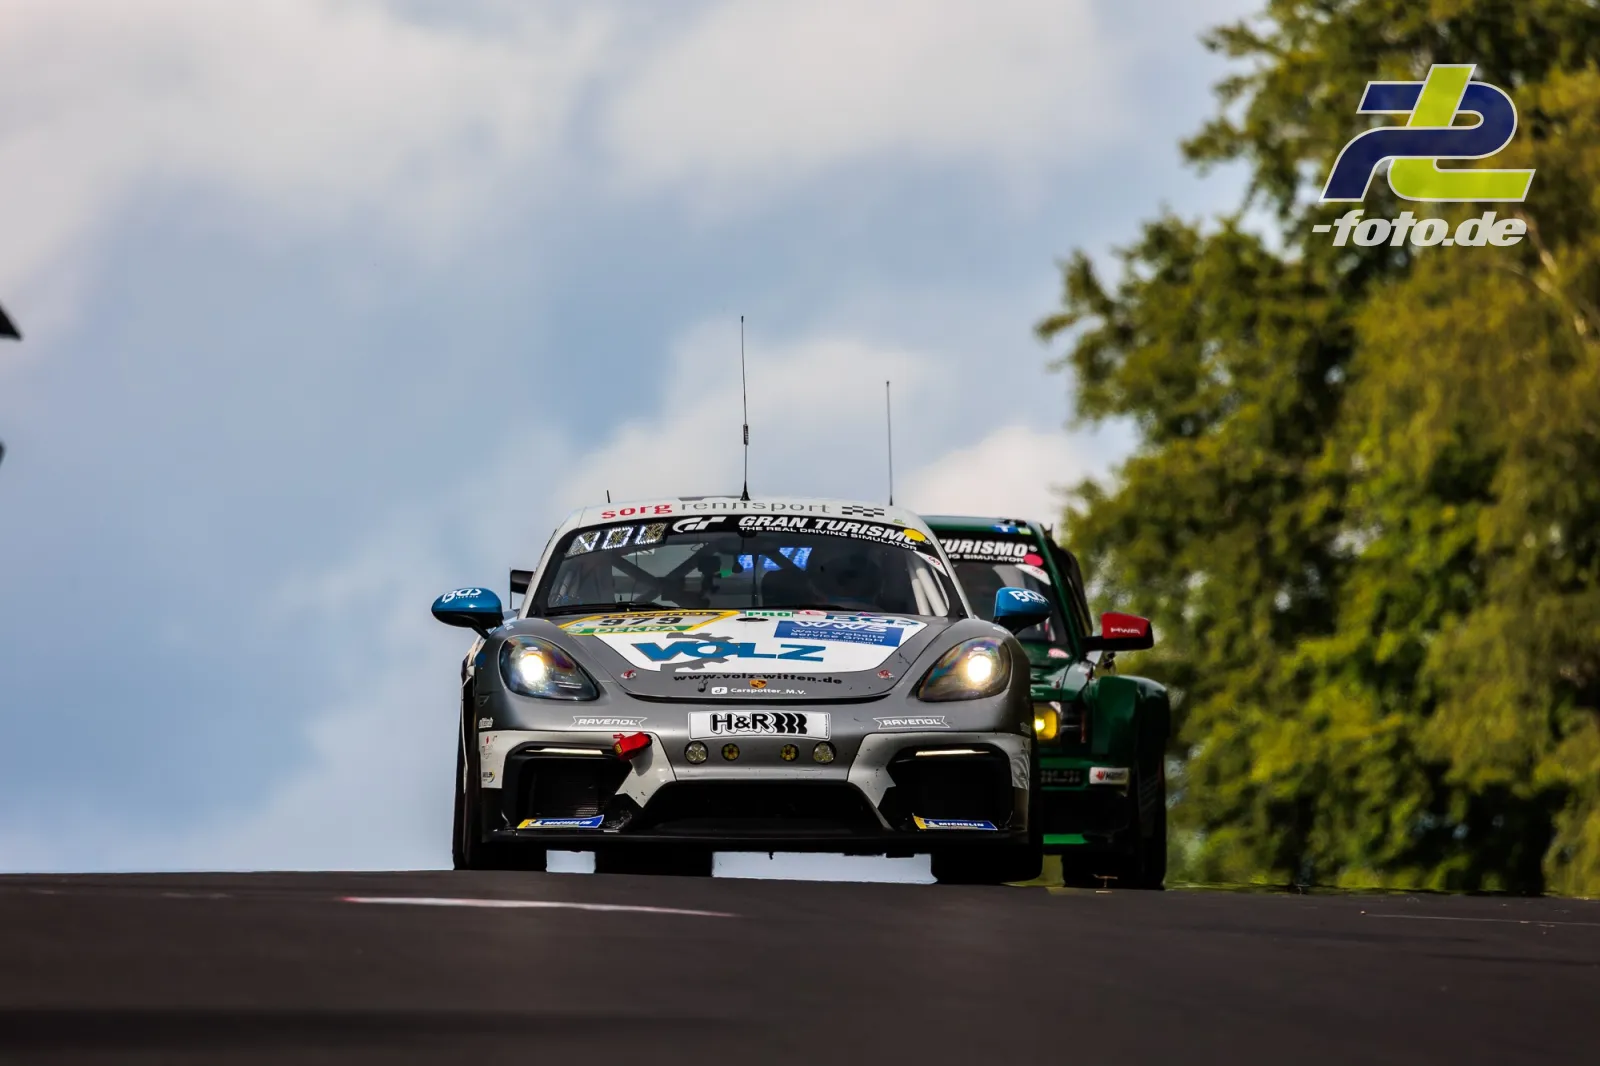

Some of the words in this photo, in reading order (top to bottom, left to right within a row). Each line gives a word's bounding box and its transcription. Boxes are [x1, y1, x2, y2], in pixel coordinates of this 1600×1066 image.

[601, 503, 673, 519] sorg
[681, 501, 830, 513] rennsport
[738, 516, 809, 528] GRAN
[799, 529, 848, 537] DRIVING
[850, 533, 917, 551] SIMULATOR
[963, 553, 1025, 563] SIMULATOR
[599, 616, 684, 627] 979
[793, 620, 888, 633] WWS
[832, 631, 885, 639] Website
[631, 640, 827, 662] VOLZ
[673, 672, 843, 684] www.volz-witten.de
[730, 687, 807, 695] Carspotter_M.V.
[577, 717, 639, 726] RAVENOL
[710, 712, 774, 734] H&R
[882, 717, 941, 726] RAVENOL
